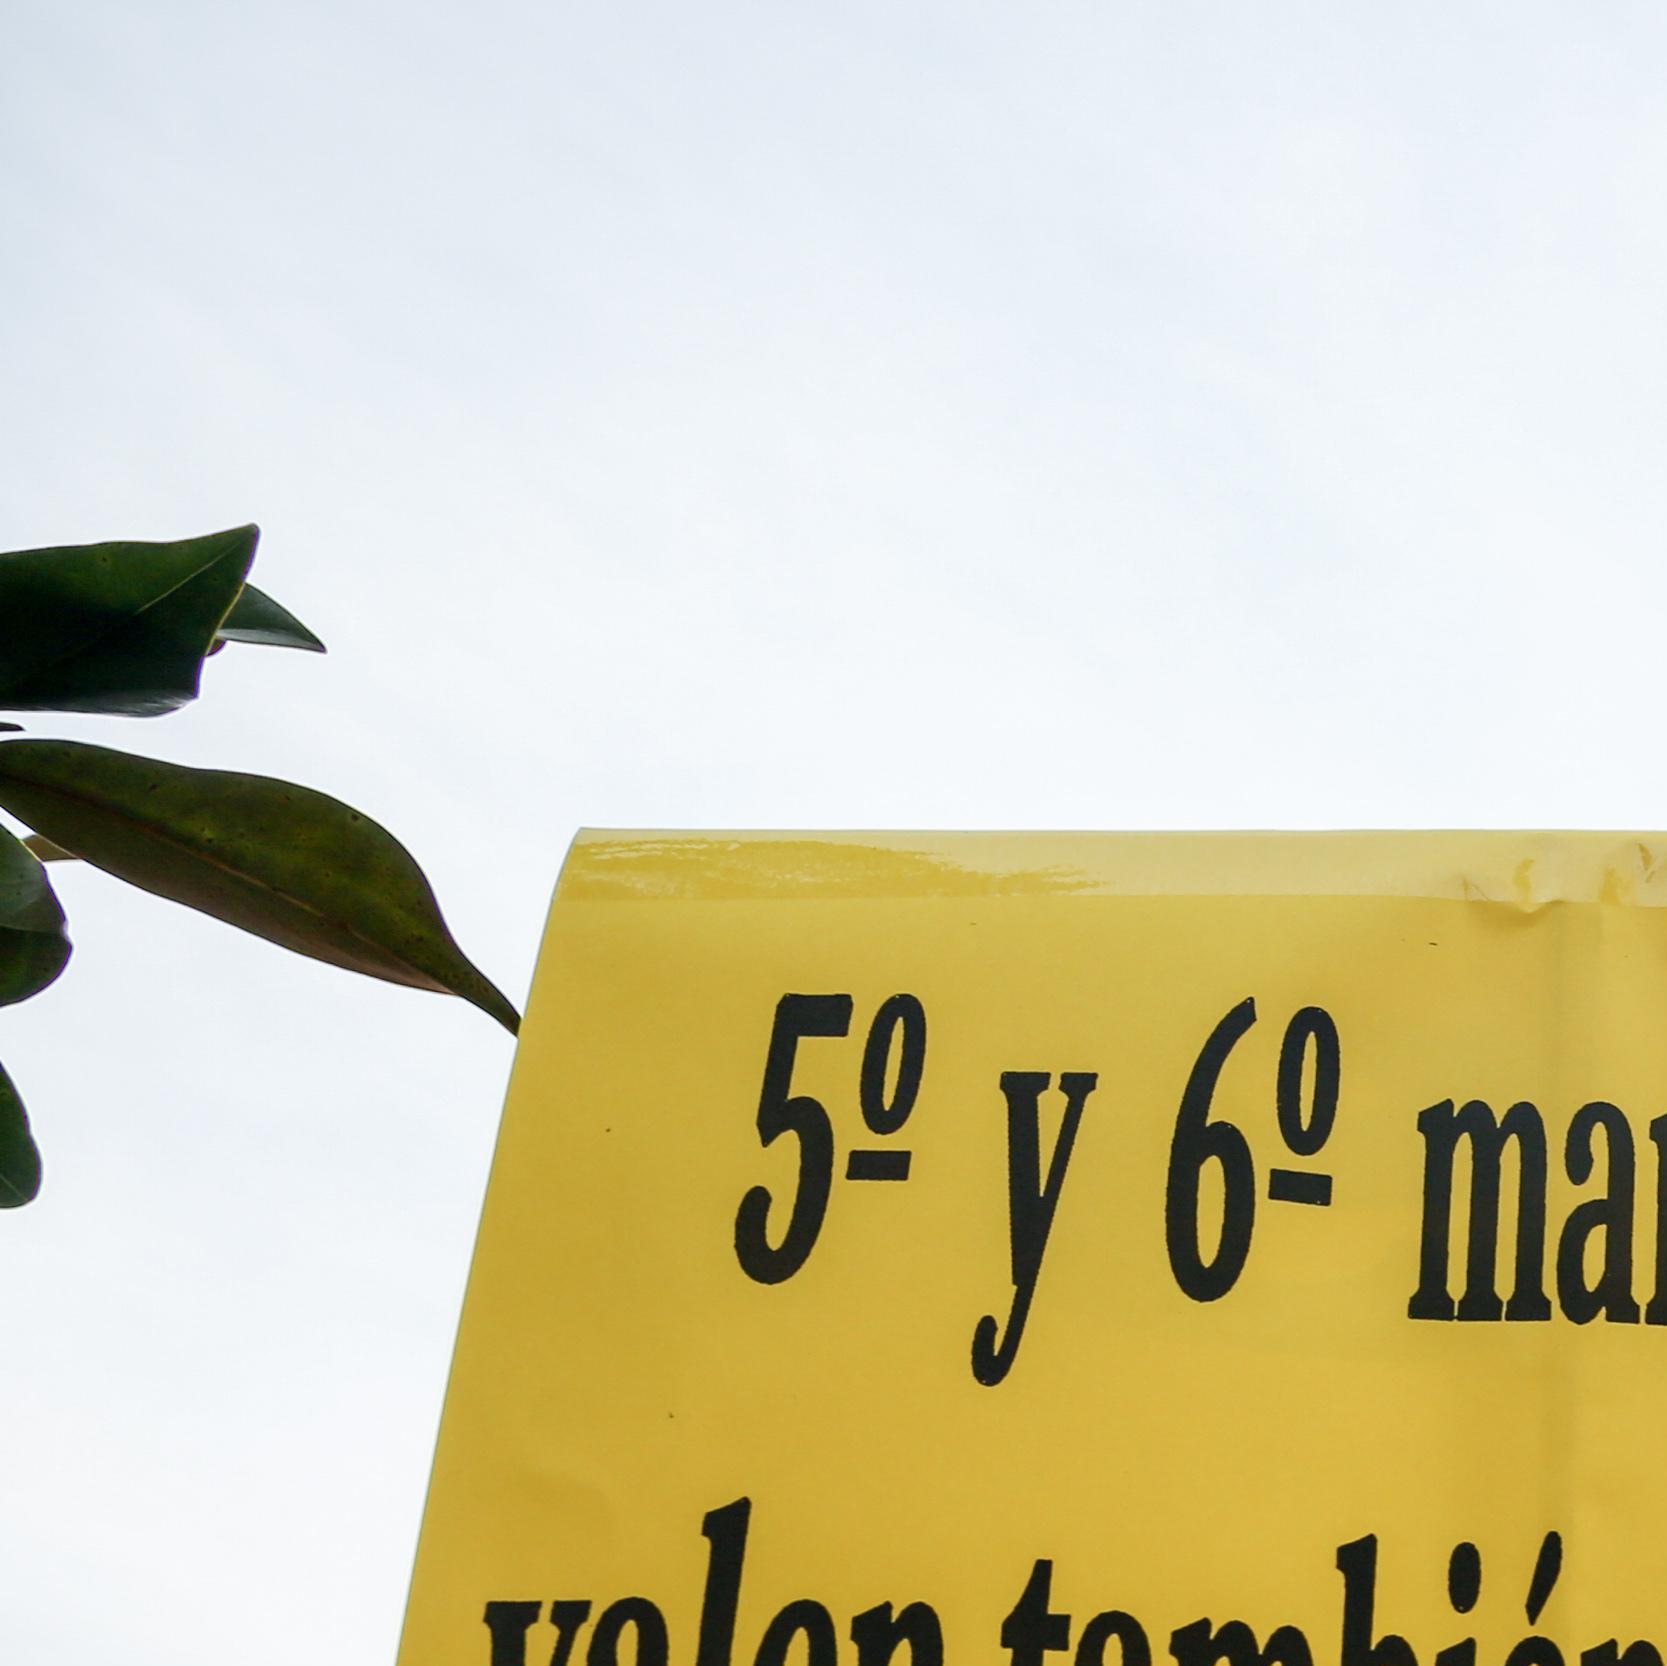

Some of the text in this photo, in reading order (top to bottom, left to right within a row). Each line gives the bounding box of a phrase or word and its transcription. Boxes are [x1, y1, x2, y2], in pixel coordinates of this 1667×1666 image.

[733, 993, 927, 1285] 5º
[971, 1071, 1098, 1387] y
[1165, 996, 1341, 1303] 6º
